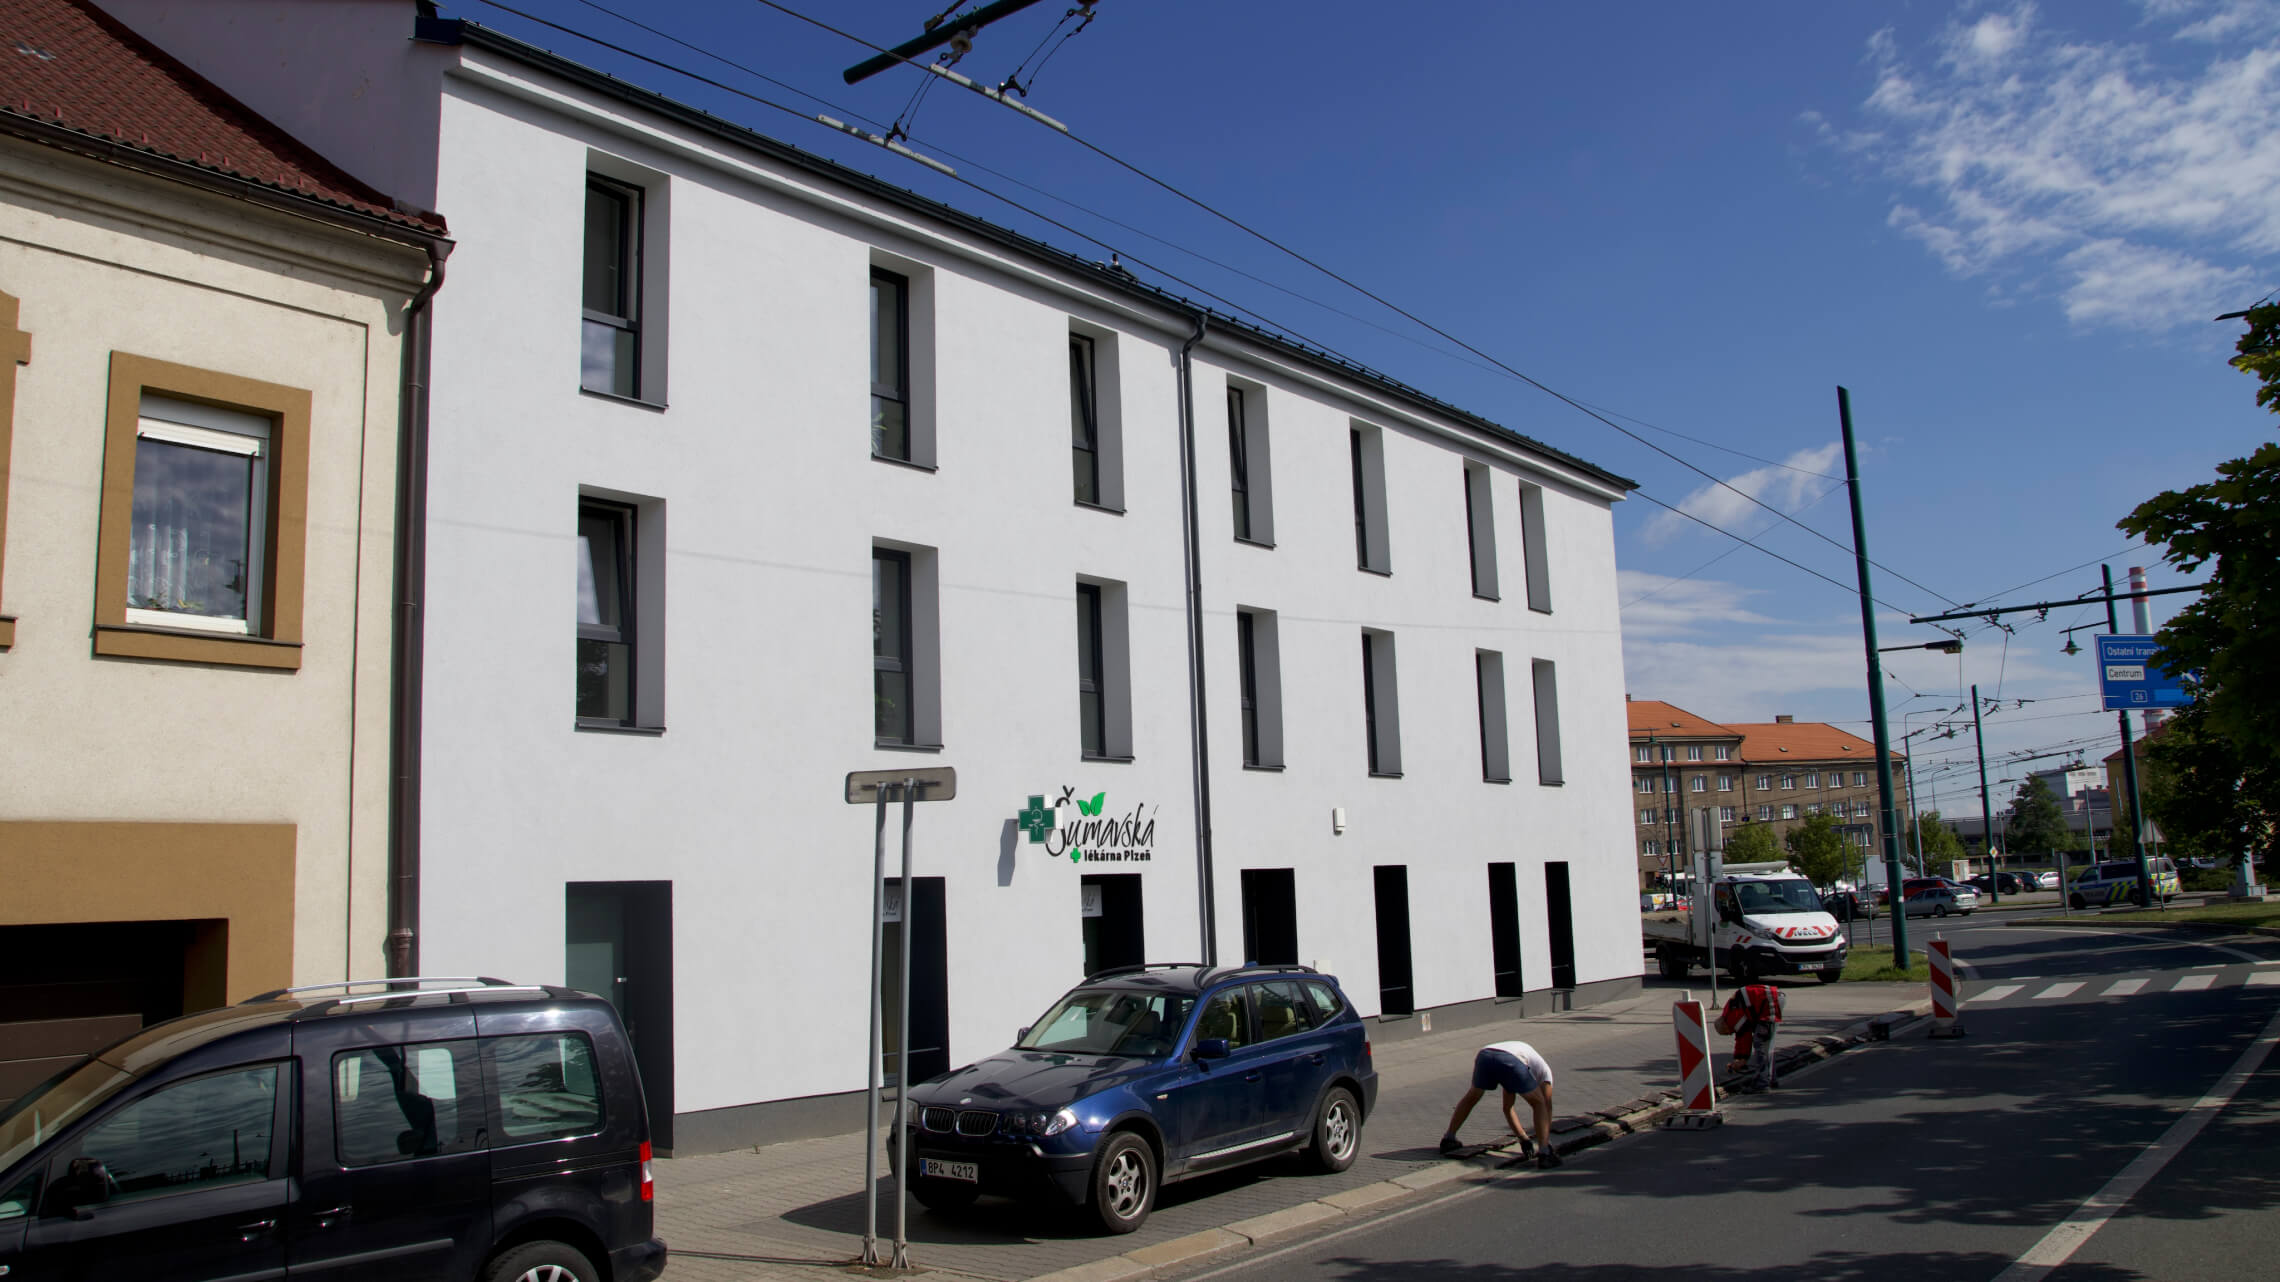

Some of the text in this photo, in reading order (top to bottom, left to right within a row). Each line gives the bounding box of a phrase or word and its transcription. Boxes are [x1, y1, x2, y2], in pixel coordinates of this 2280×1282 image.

[2107, 646, 2134, 656] Ostatní
[2108, 668, 2142, 678] Centrum
[1046, 785, 1159, 857] Šumavská
[1084, 849, 1151, 862] lékárna Plzeň
[928, 1161, 974, 1179] 8P4 4212
